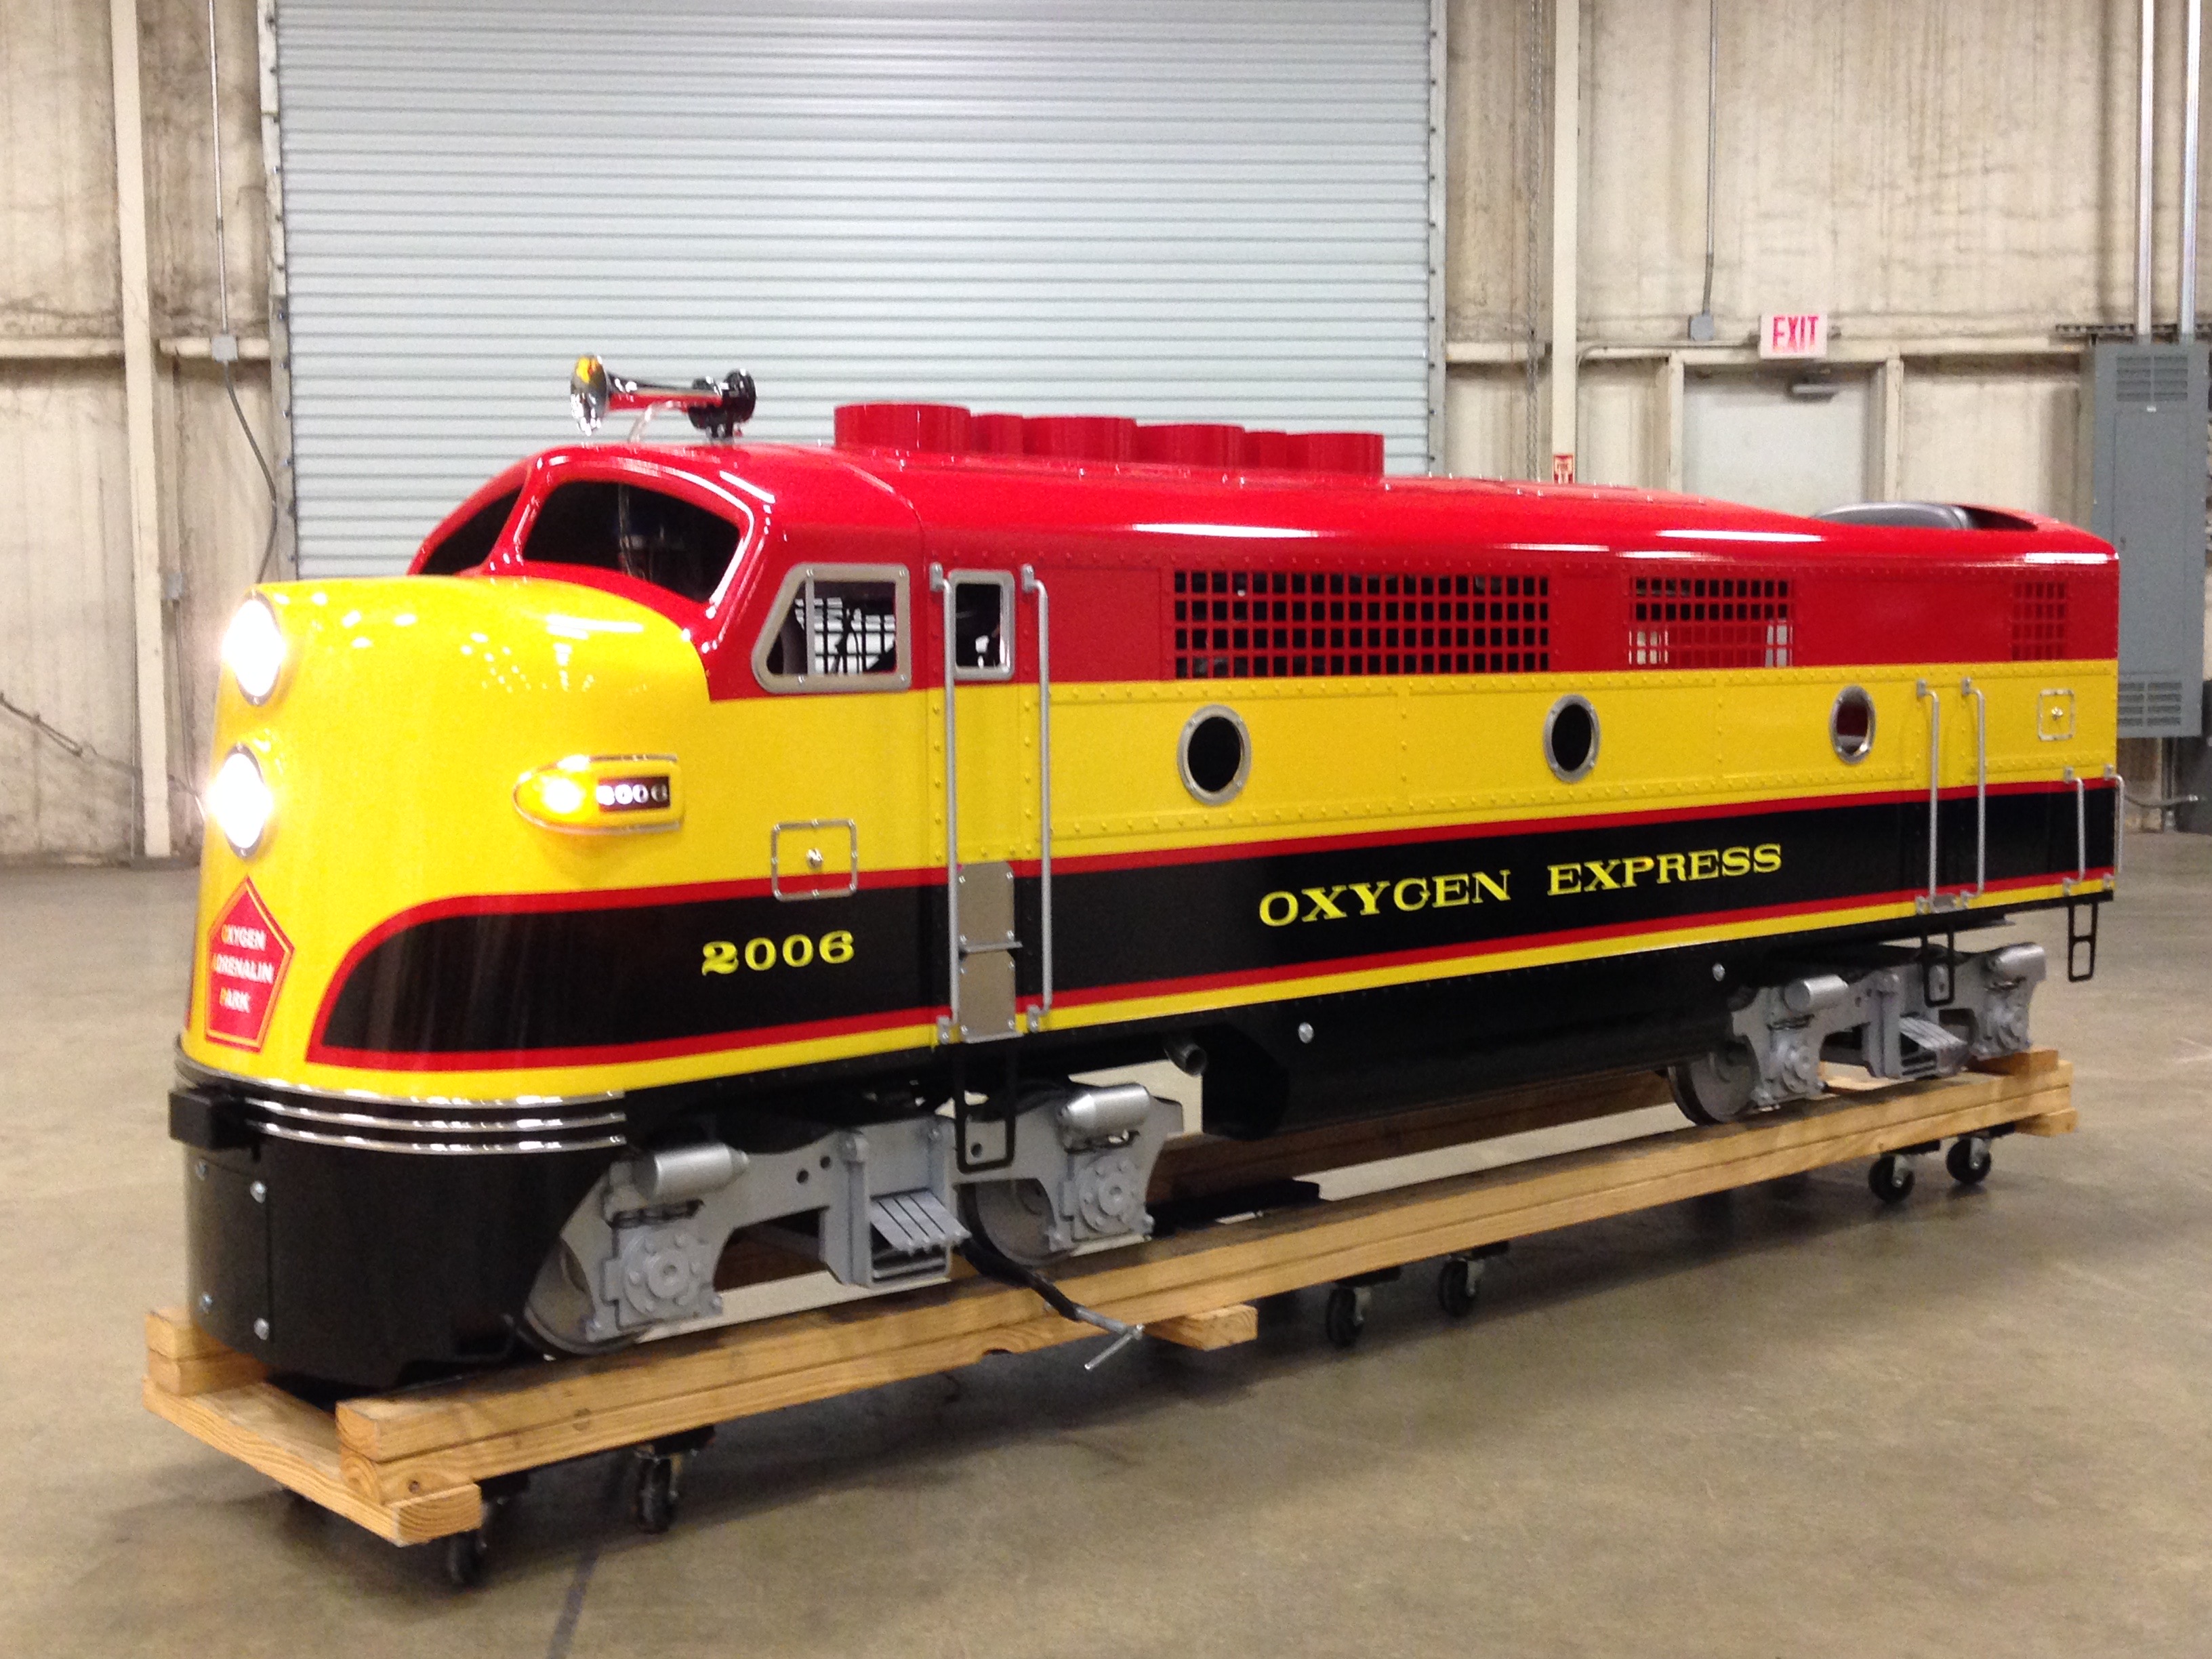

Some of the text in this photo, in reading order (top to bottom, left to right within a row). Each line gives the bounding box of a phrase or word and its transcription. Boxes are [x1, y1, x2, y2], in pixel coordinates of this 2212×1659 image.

[1772, 316, 1819, 351] EXIT
[1259, 842, 1782, 926] OXYGEN EXPRESS
[221, 924, 267, 951] OXYGEN
[701, 930, 855, 976] 2006
[219, 987, 251, 1013] PARK
